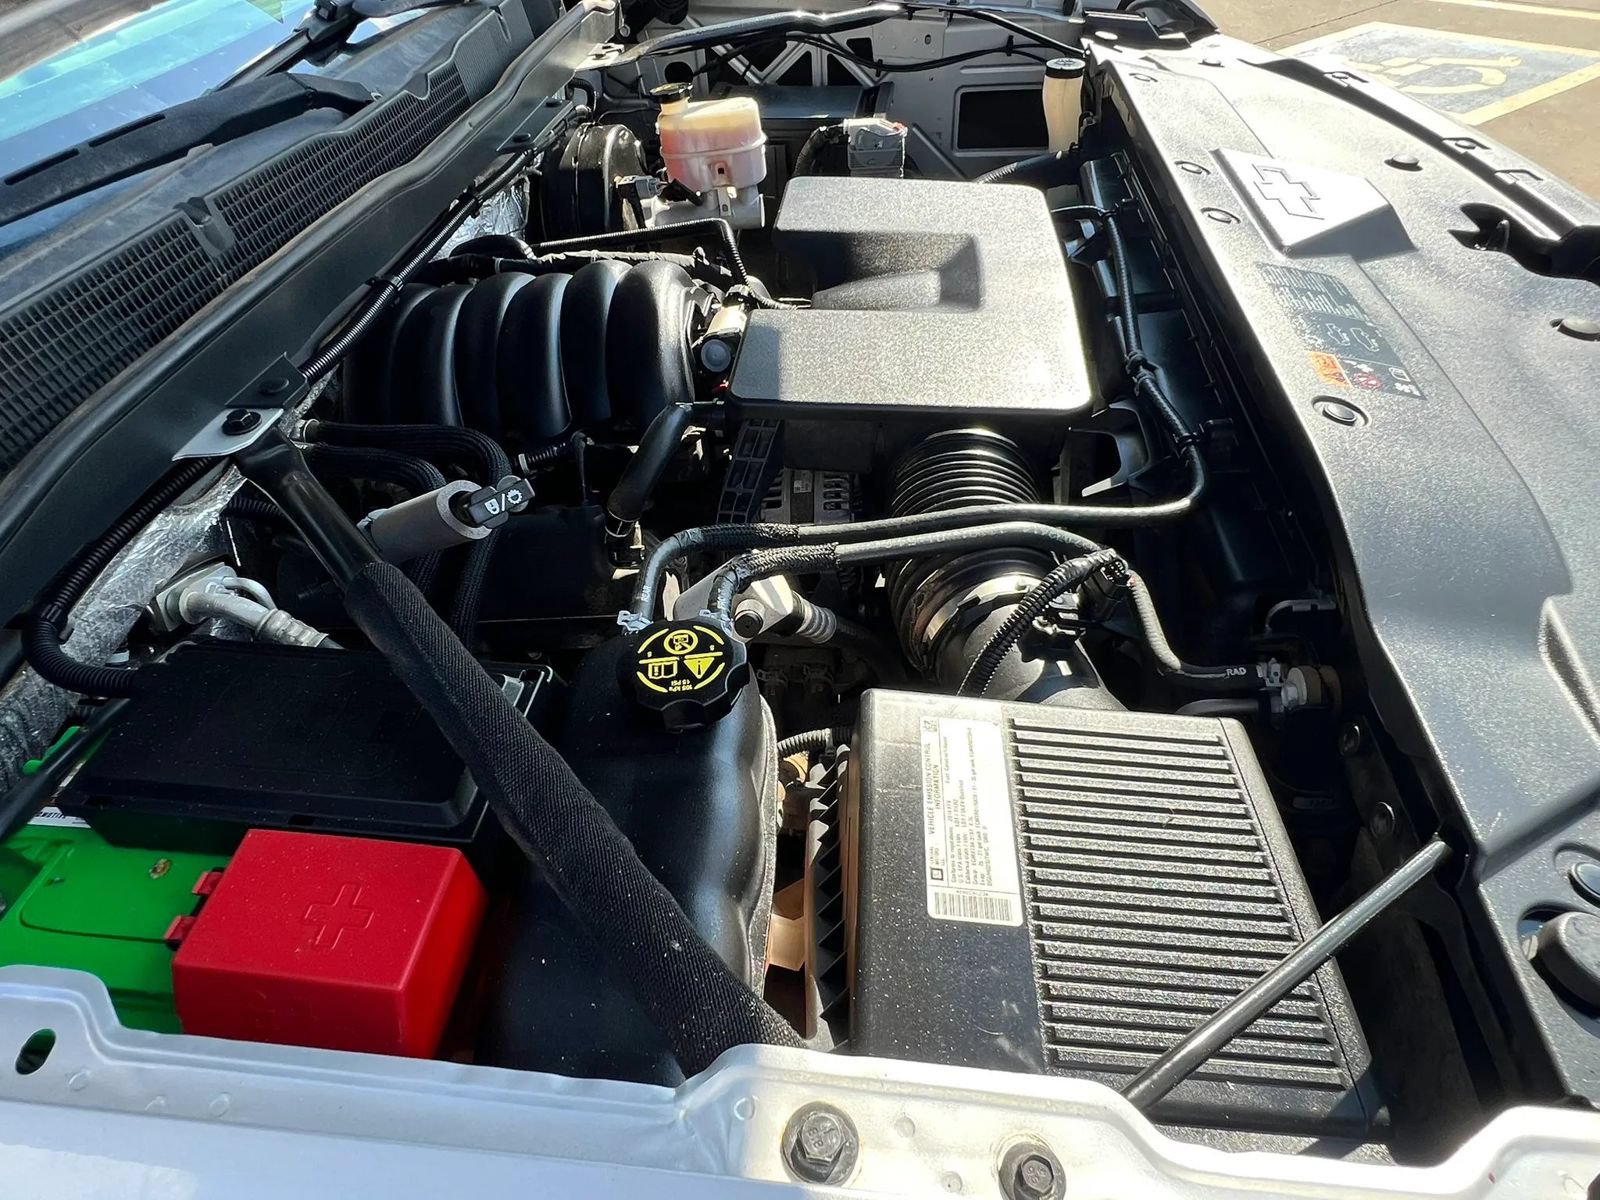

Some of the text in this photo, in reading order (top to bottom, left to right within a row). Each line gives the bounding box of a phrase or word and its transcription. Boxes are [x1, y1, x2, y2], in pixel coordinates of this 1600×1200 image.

[1226, 667, 1247, 677] RAD
[923, 741, 931, 771] CONTROL
[925, 772, 933, 804] EMISSION
[932, 764, 941, 809] INFORMATION
[926, 806, 935, 834] VEHICLE
